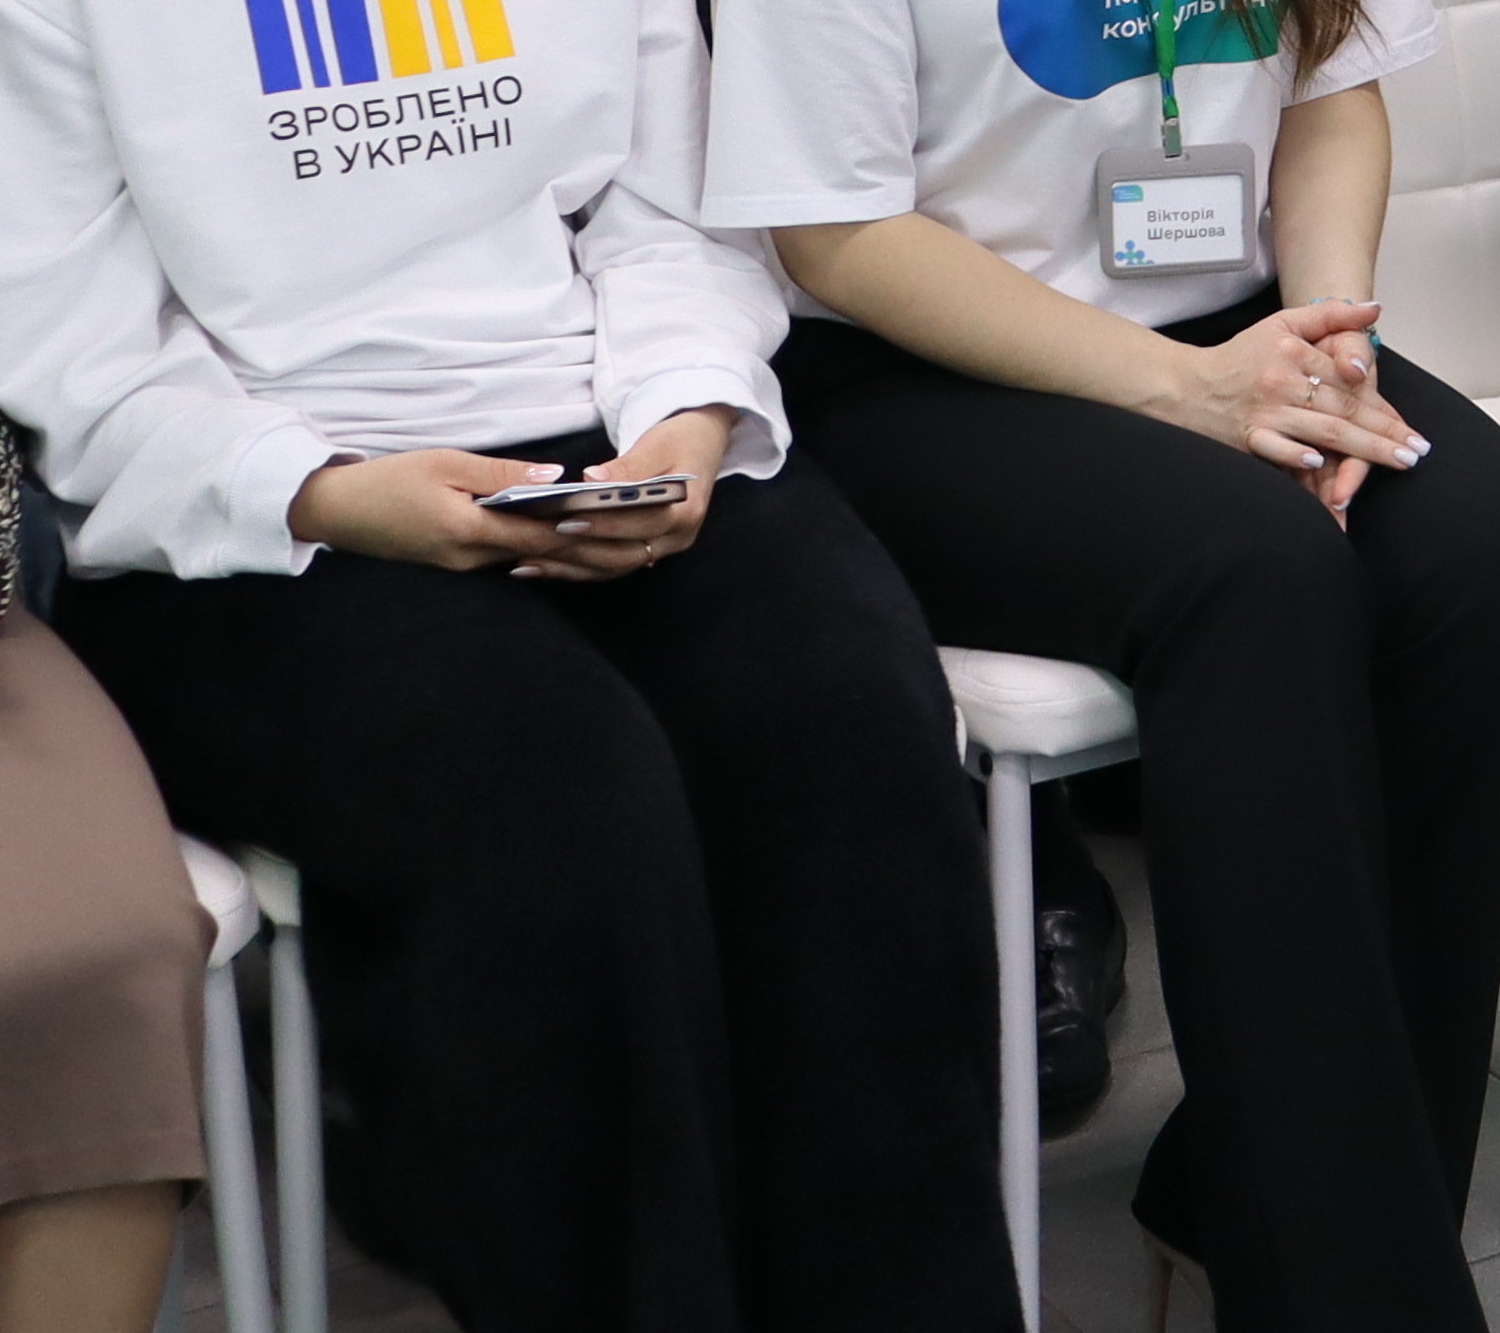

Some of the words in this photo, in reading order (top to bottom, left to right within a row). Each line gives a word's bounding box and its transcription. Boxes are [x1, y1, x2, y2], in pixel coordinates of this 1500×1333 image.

[268, 75, 522, 141] ЗРОБЛЕНО
[293, 149, 322, 179] В
[334, 117, 512, 174] УКРАЇНІ
[1147, 208, 1214, 223] Вікторія
[1147, 226, 1226, 242] Шершова
